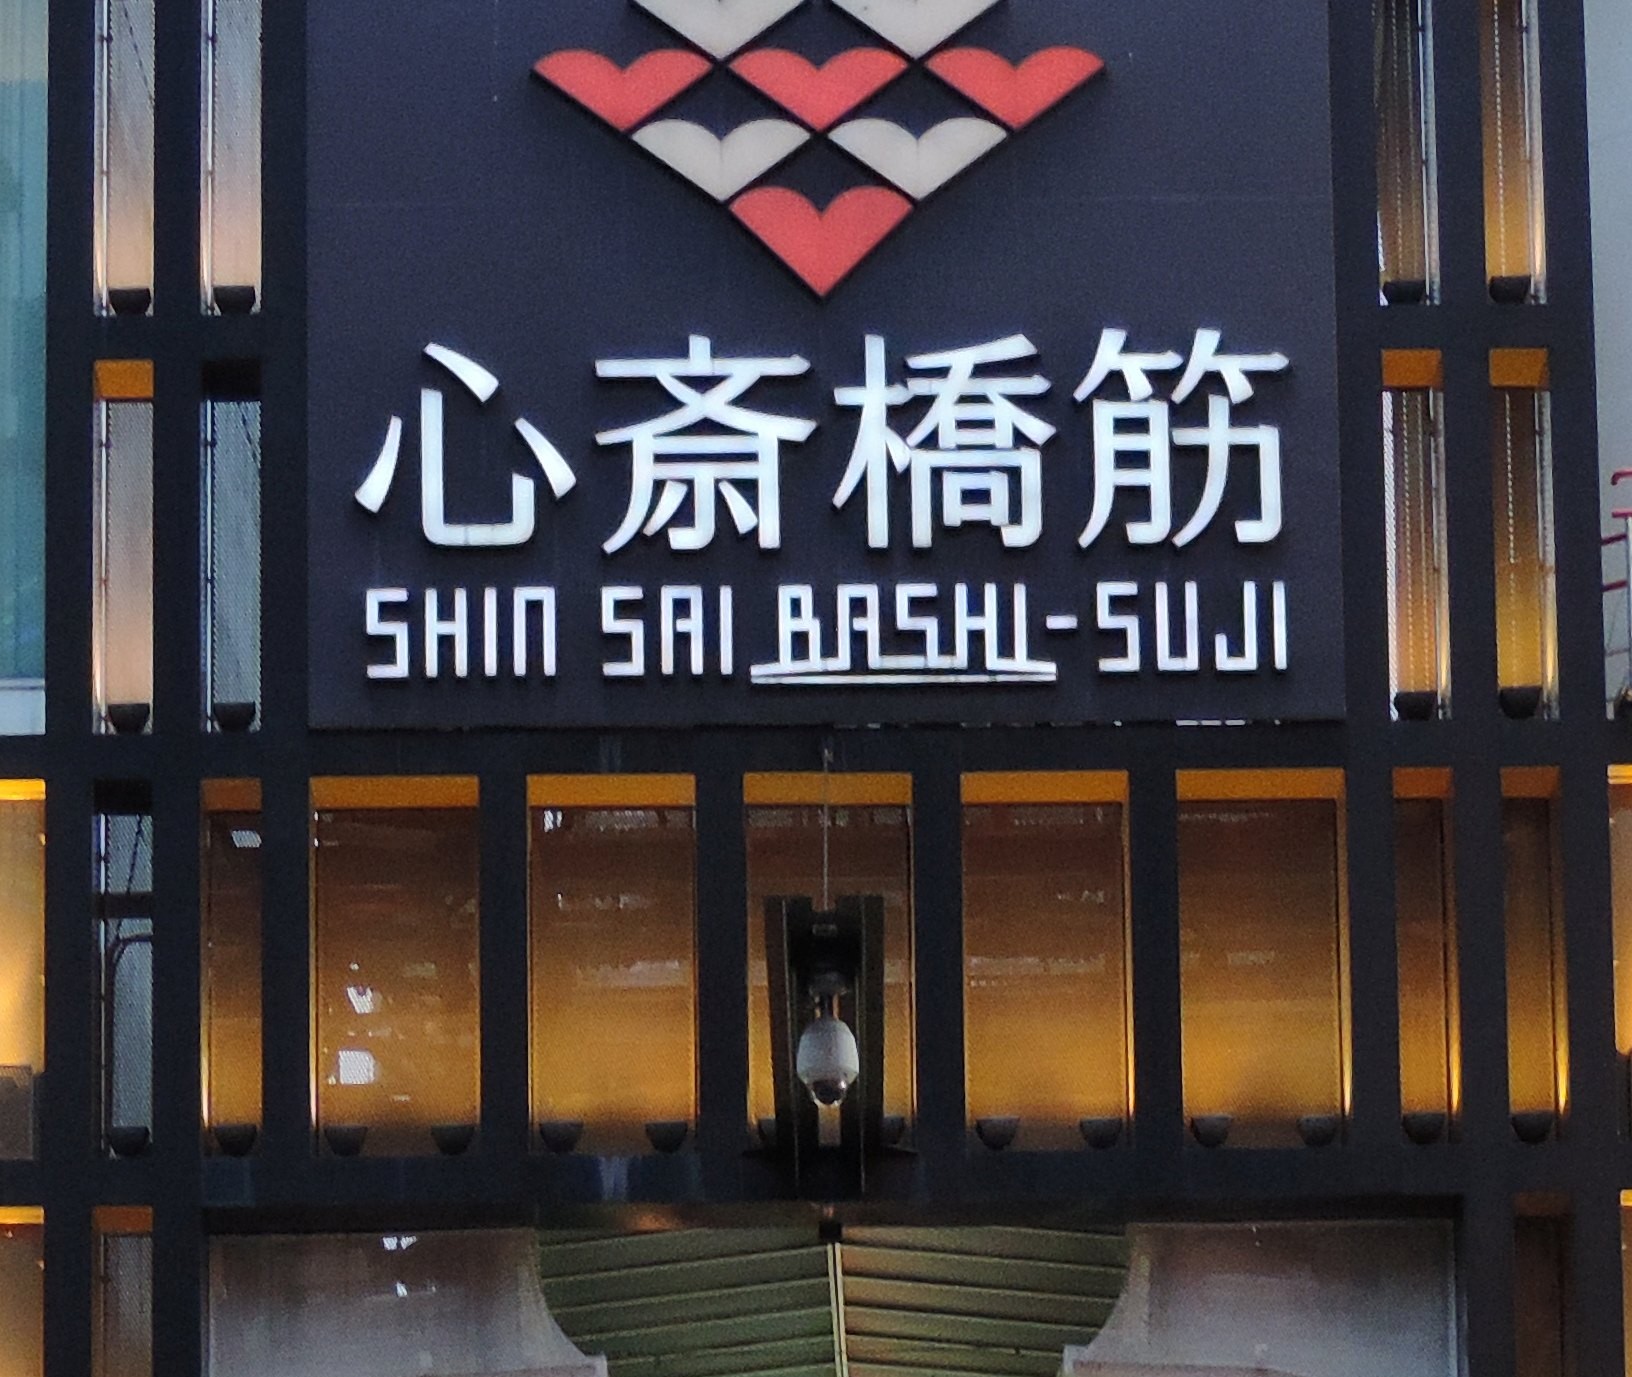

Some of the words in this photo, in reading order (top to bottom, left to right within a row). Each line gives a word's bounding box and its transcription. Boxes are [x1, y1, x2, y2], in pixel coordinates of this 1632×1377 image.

[354, 328, 1290, 554] 心斎橋筋
[366, 587, 556, 680] SHIN
[600, 585, 735, 677] SAI
